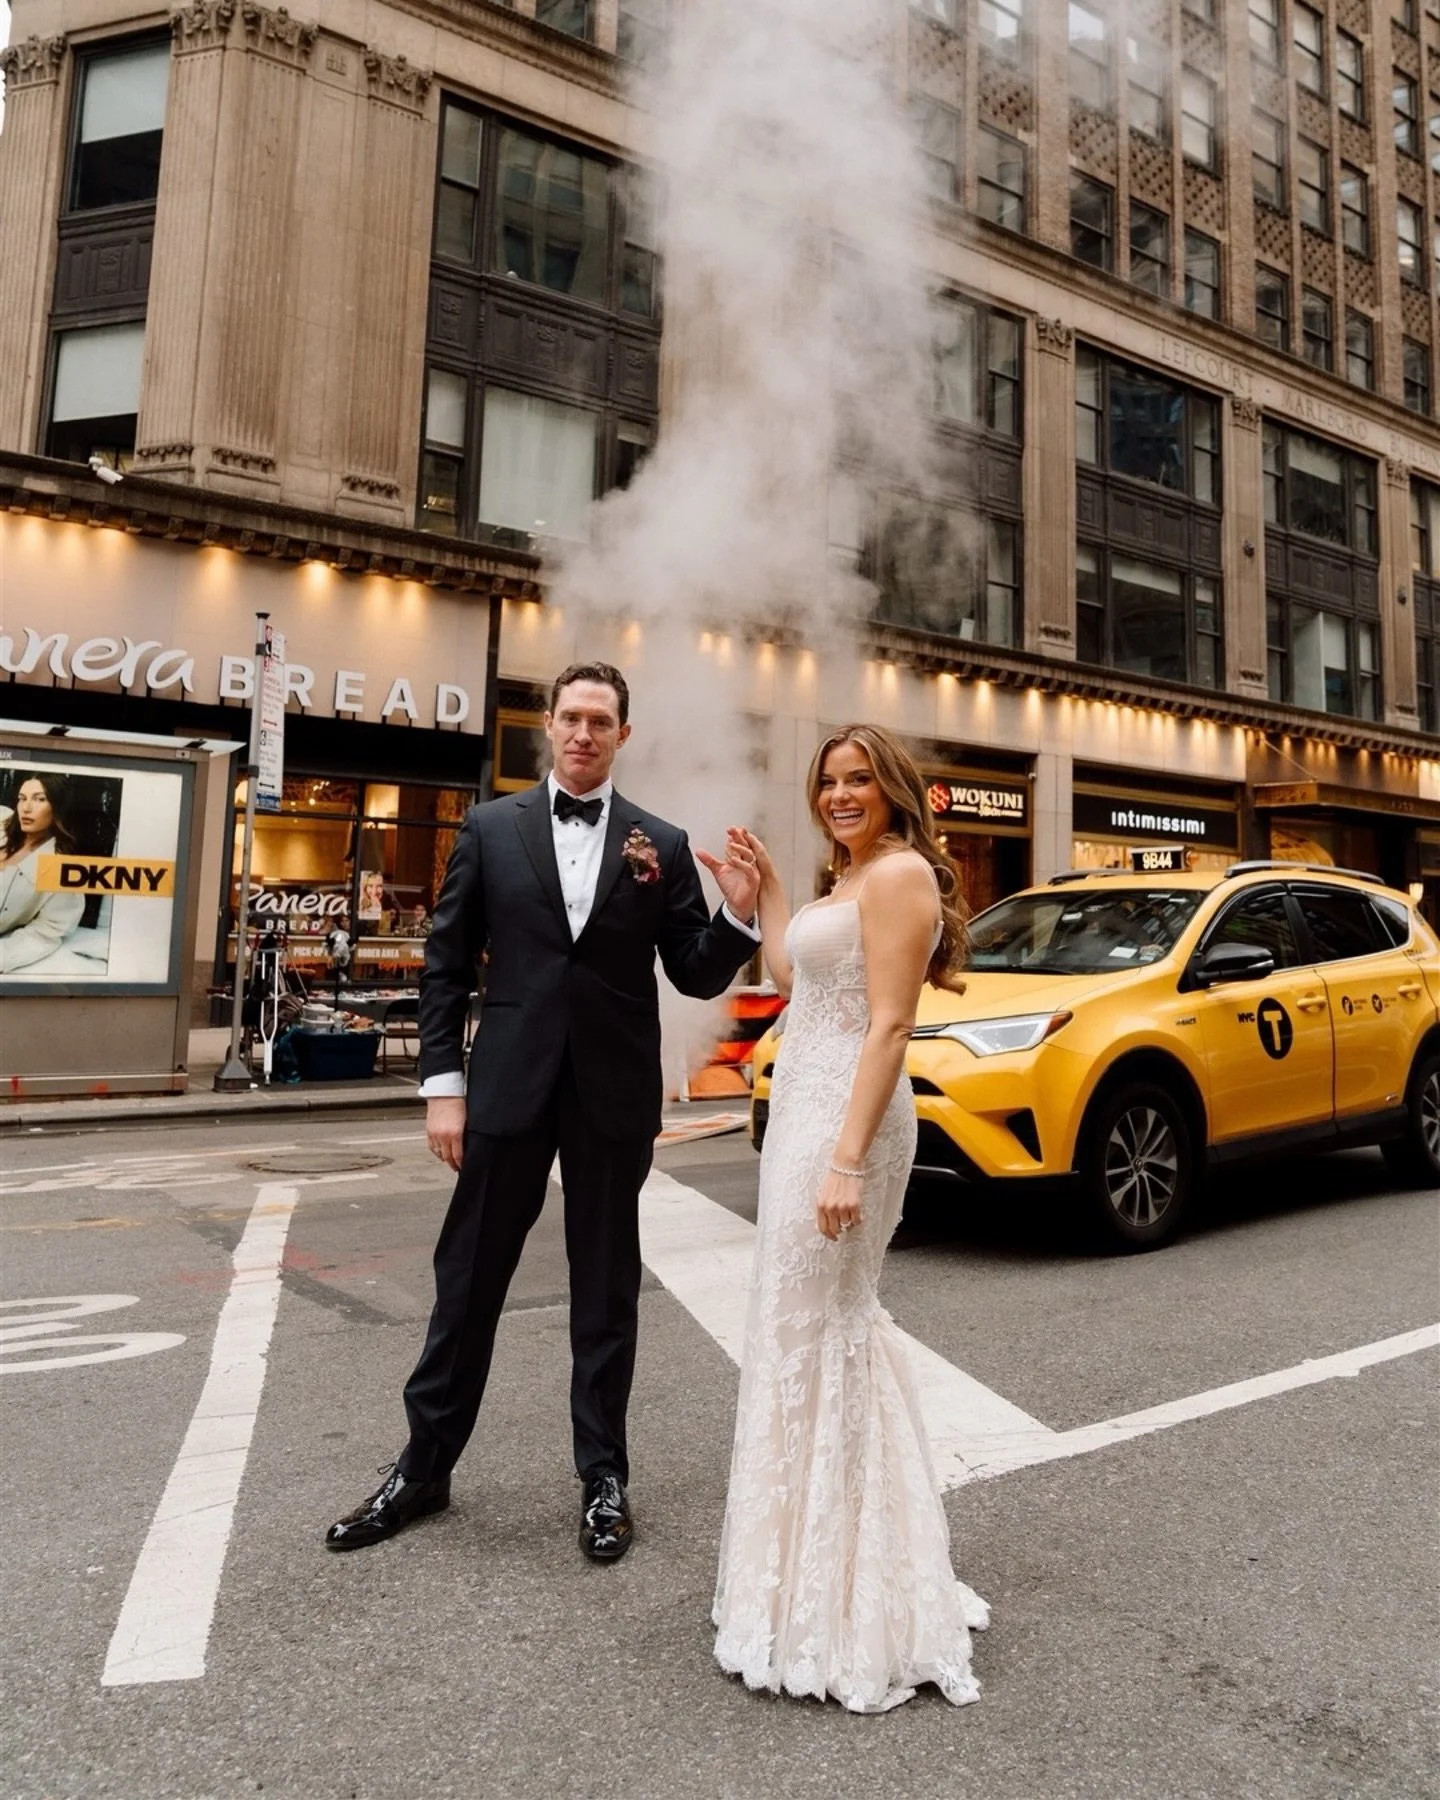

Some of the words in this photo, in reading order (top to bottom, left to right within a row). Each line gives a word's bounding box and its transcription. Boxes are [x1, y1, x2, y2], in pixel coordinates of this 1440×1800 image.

[1160, 338, 1255, 394] LEFCOURT
[1281, 387, 1368, 441] MARLBORO
[219, 655, 470, 724] BREAD
[949, 786, 1024, 810] WOKUNI
[1111, 810, 1205, 835] intimissimi
[1142, 852, 1172, 869] 9B44
[60, 863, 168, 891] DKNY
[265, 919, 321, 931] BREAD
[1237, 1012, 1255, 1024] NYC
[1262, 1010, 1283, 1051] T
